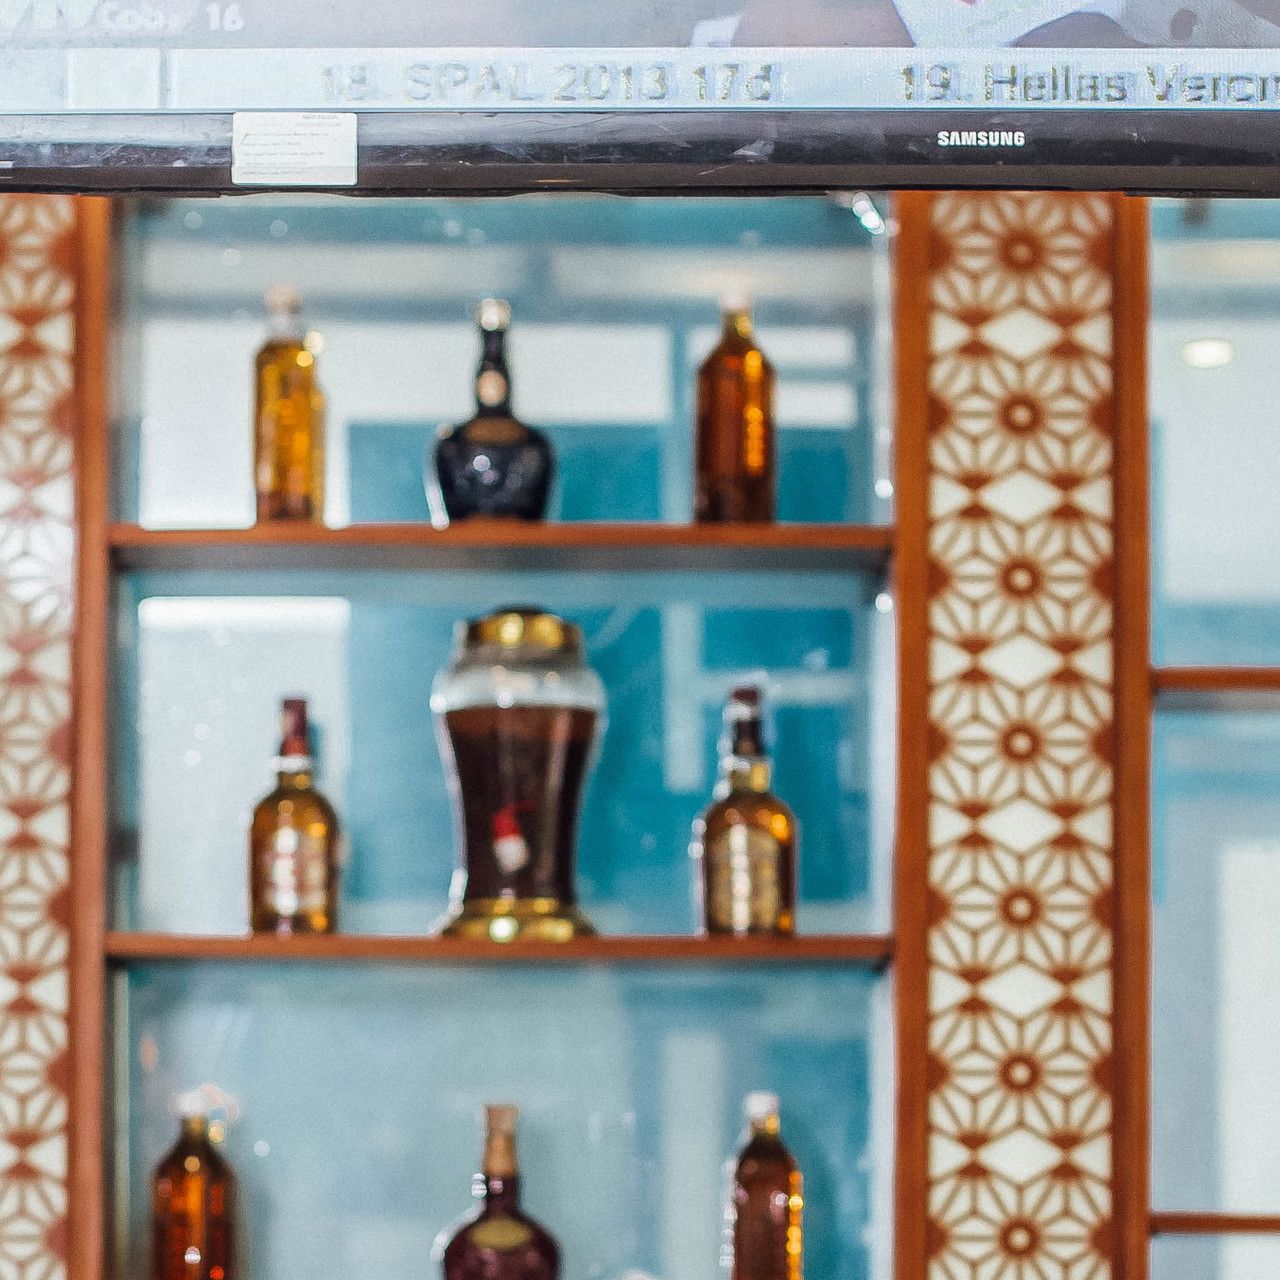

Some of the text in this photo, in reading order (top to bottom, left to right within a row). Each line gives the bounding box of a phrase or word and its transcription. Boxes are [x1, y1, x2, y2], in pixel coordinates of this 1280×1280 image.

[206, 2, 245, 32] 16
[404, 62, 538, 101] SPAL
[552, 62, 667, 101] 2013
[691, 62, 773, 102] 17d
[984, 63, 1130, 102] Hellas
[936, 130, 1026, 147] SAMSUNG
